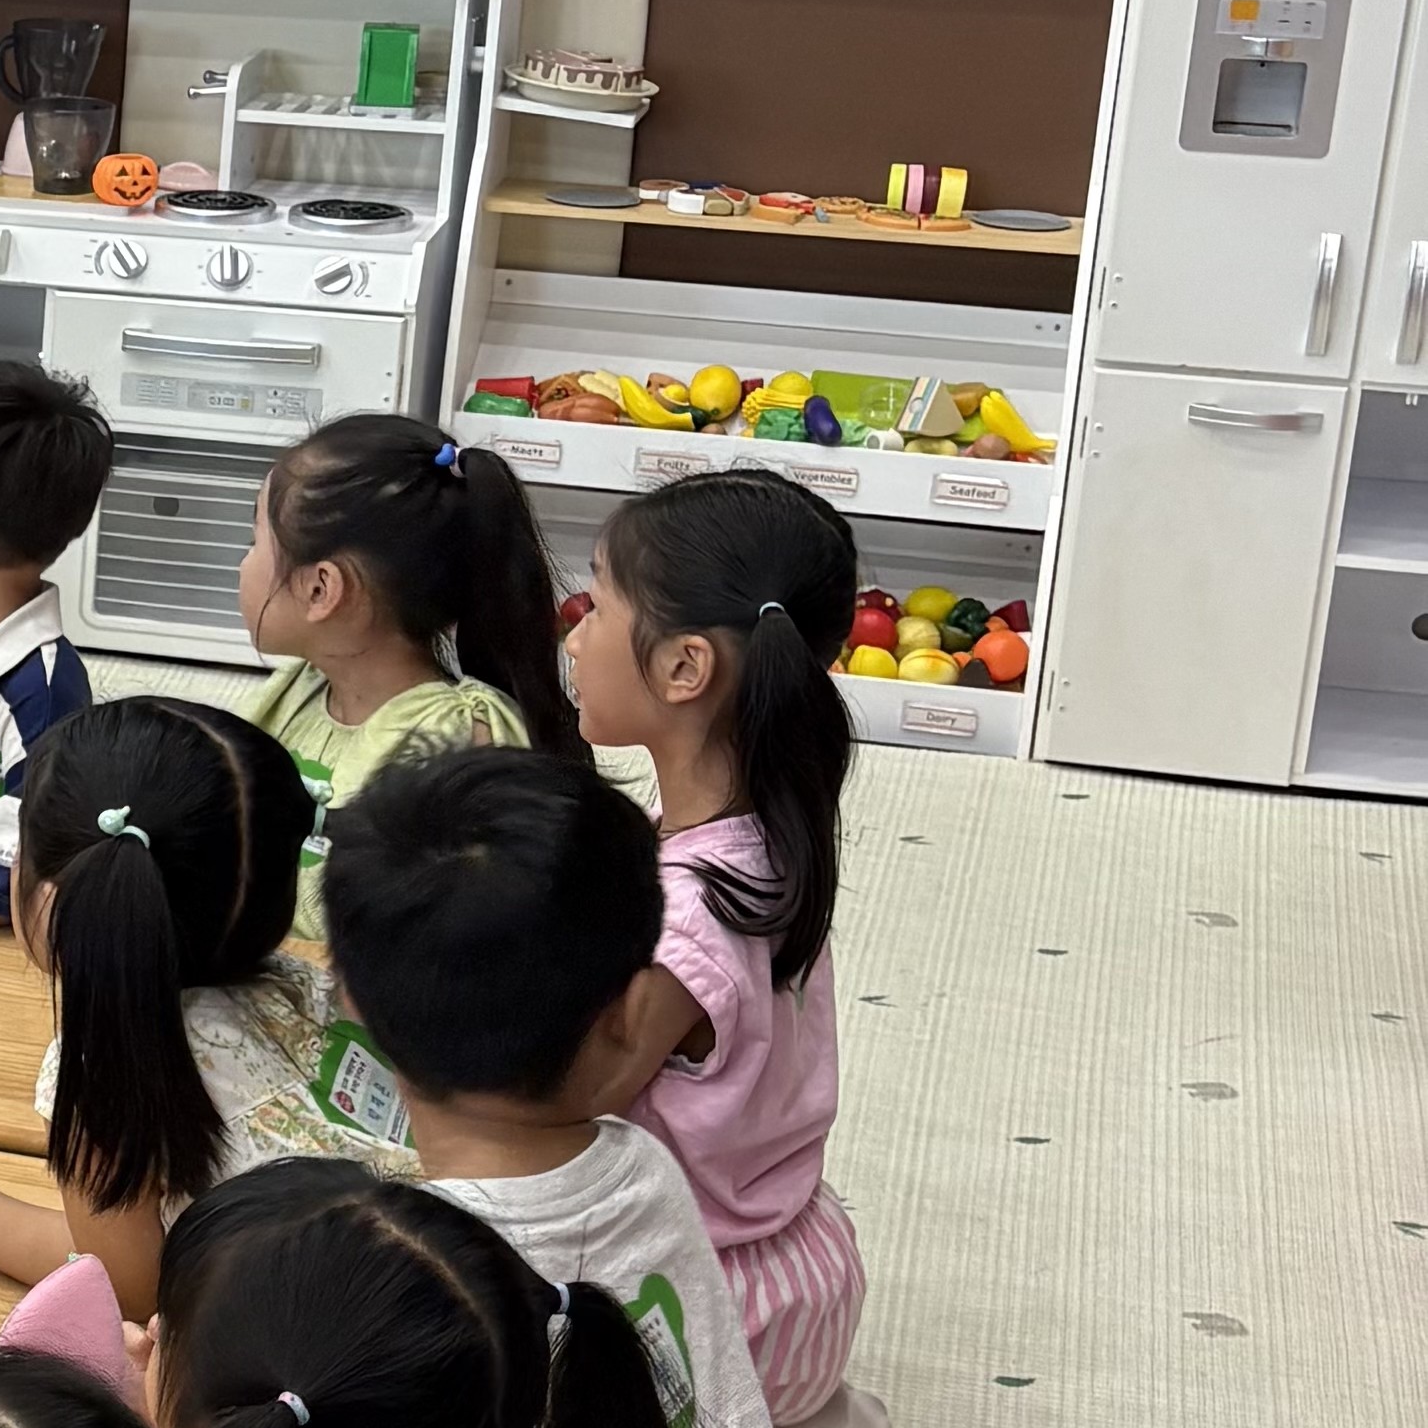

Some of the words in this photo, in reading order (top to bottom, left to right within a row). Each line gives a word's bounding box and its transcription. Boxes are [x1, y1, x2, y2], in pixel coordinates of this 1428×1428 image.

[656, 457, 691, 472] Fruits
[793, 470, 853, 486] Vegetables
[948, 484, 997, 500] Seafood
